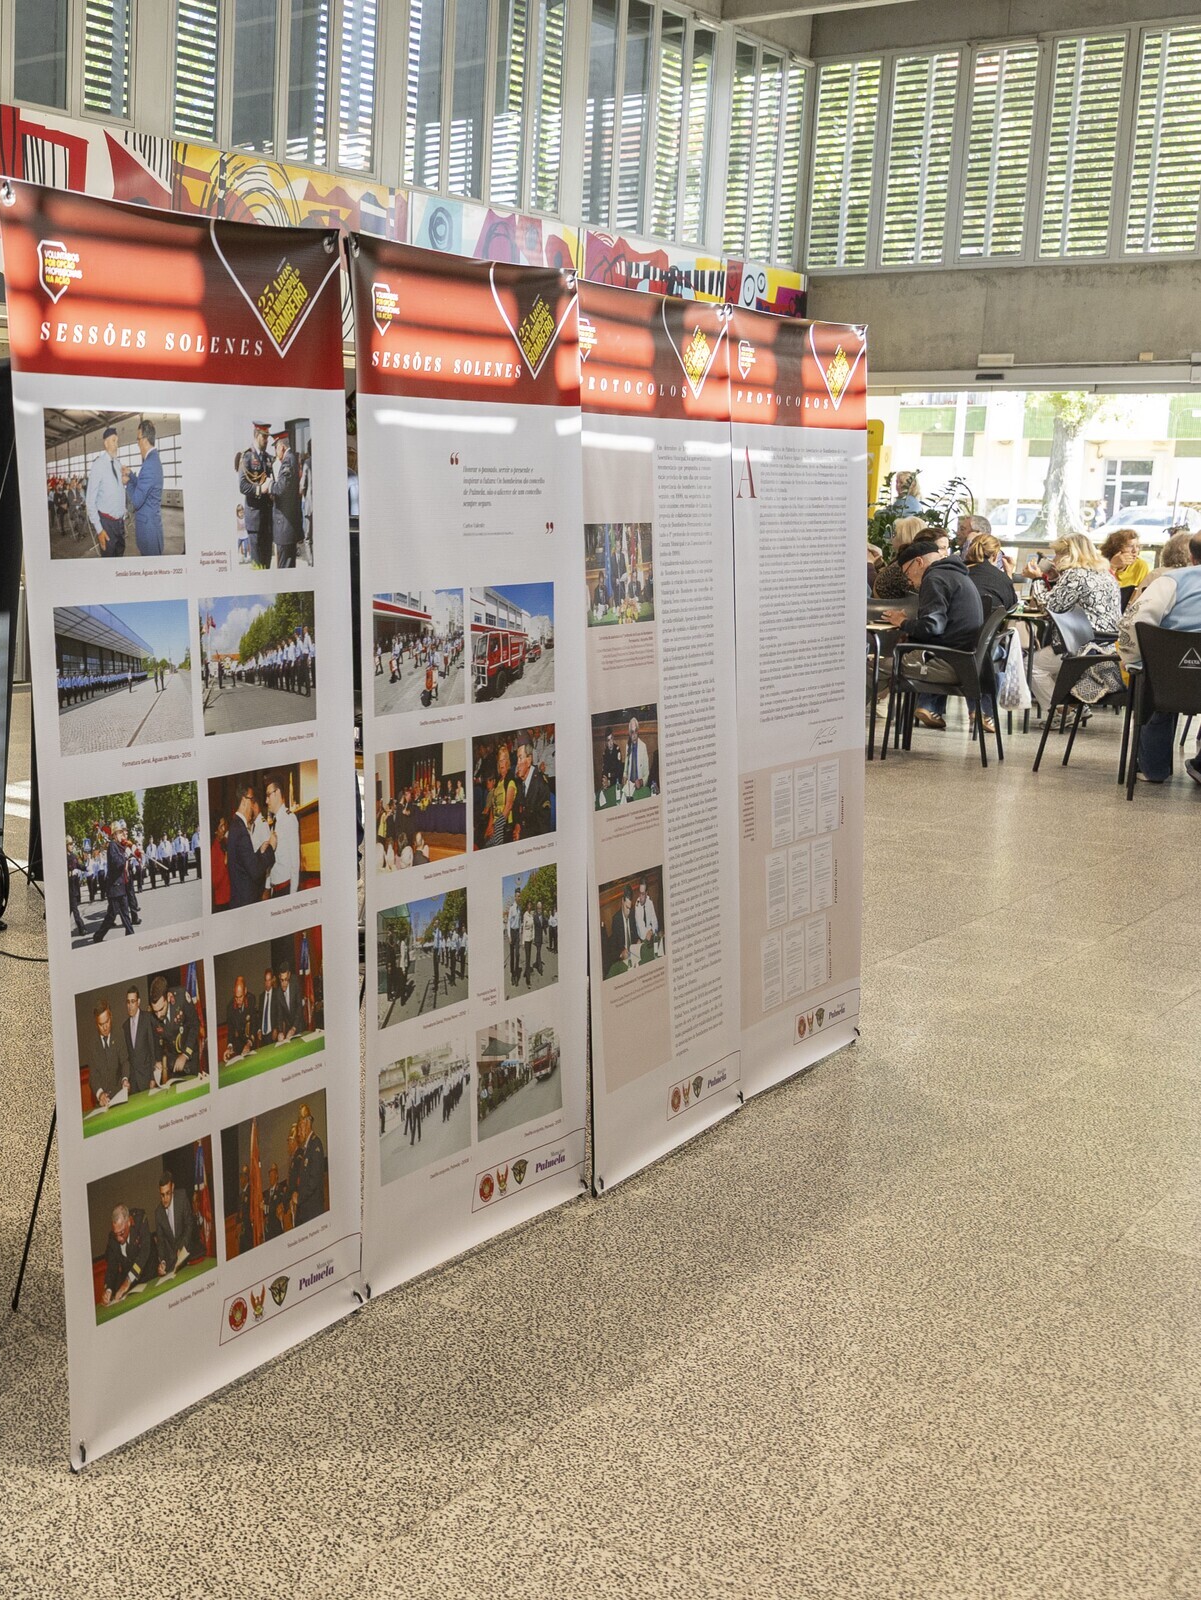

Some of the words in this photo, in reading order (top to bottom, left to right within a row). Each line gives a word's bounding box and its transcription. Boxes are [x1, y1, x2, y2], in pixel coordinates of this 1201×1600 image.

[258, 284, 274, 318] 25
[271, 282, 308, 344] BOMBEIRO
[40, 322, 146, 348] SESSÕES
[165, 332, 263, 356] SOLENES
[527, 314, 556, 368] BOMBEIRO
[372, 352, 442, 372] SESSÕES
[454, 359, 522, 379] SOLENES
[736, 390, 829, 410] PROTOCOLOS
[536, 1154, 566, 1173] Palmela
[299, 1264, 334, 1291] Palmela
